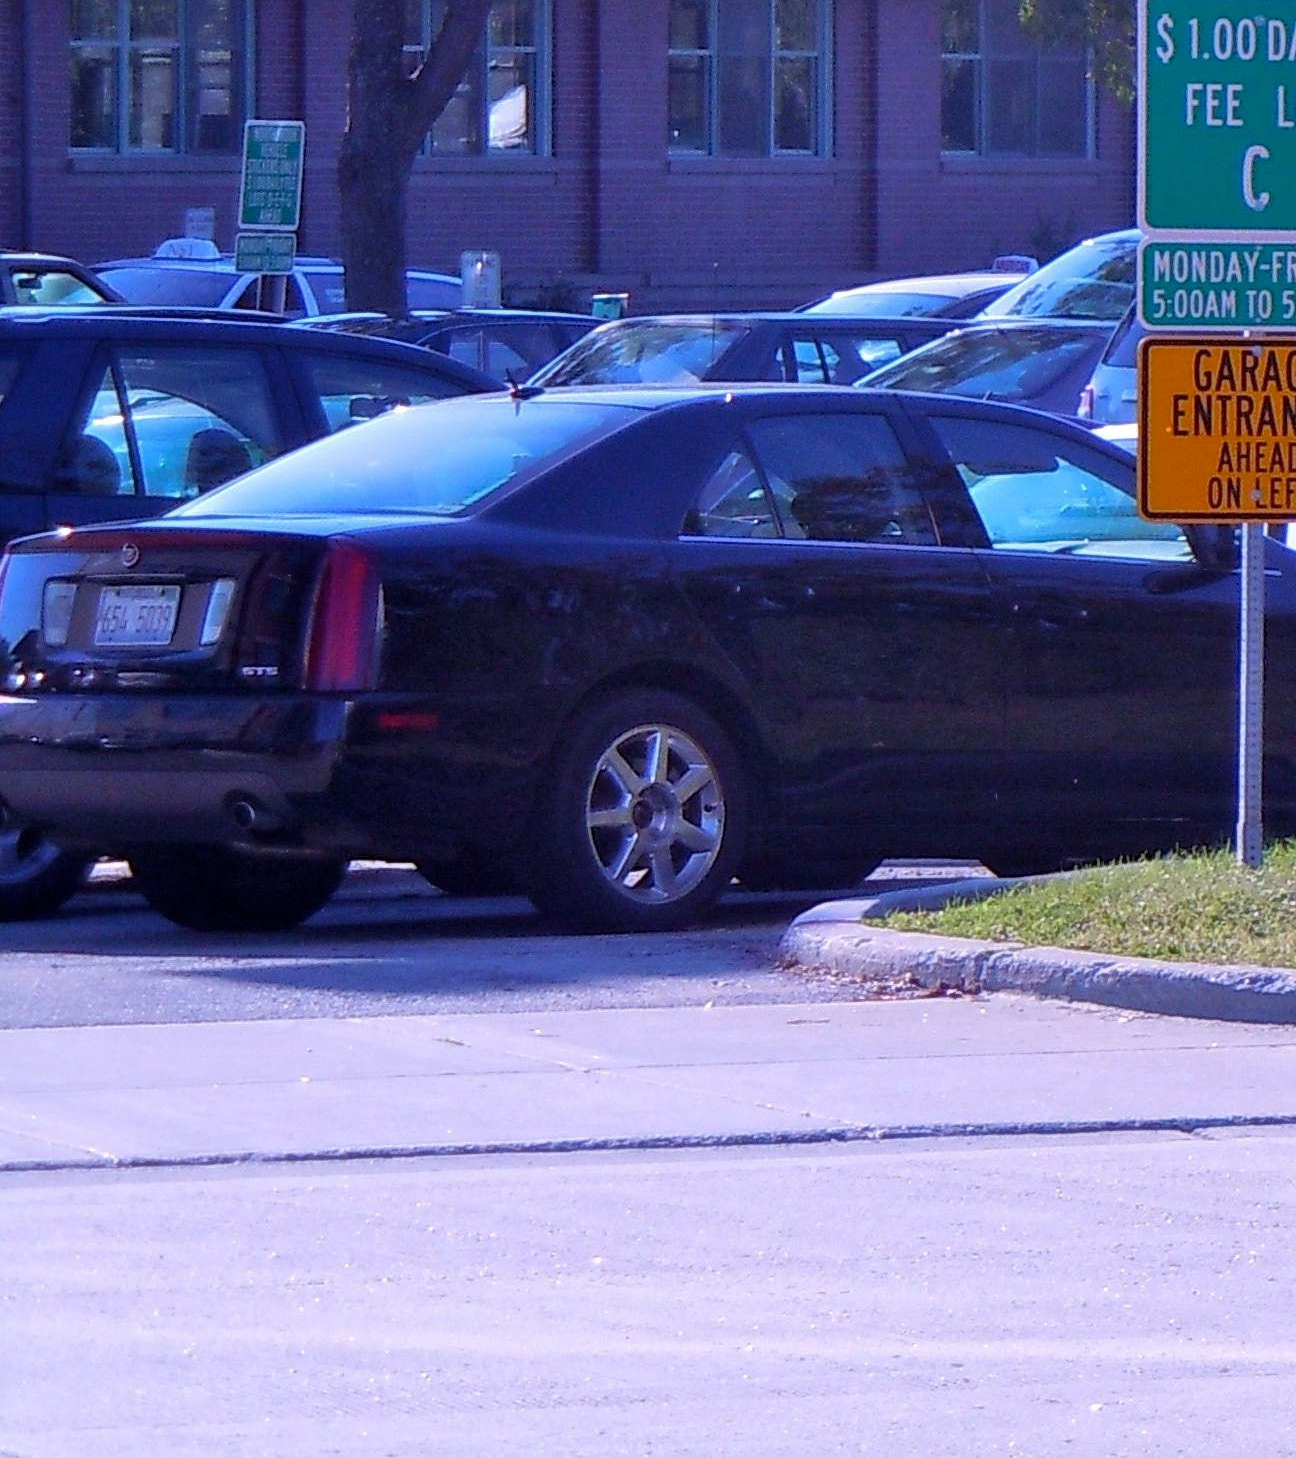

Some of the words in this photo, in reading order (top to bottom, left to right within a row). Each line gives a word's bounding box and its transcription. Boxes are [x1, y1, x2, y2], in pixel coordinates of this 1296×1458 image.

[1185, 82, 1244, 126] FEE
[1242, 144, 1270, 210] C
[1152, 290, 1237, 319] 5:00AM
[1246, 290, 1273, 319] TO
[1207, 477, 1241, 510] ON
